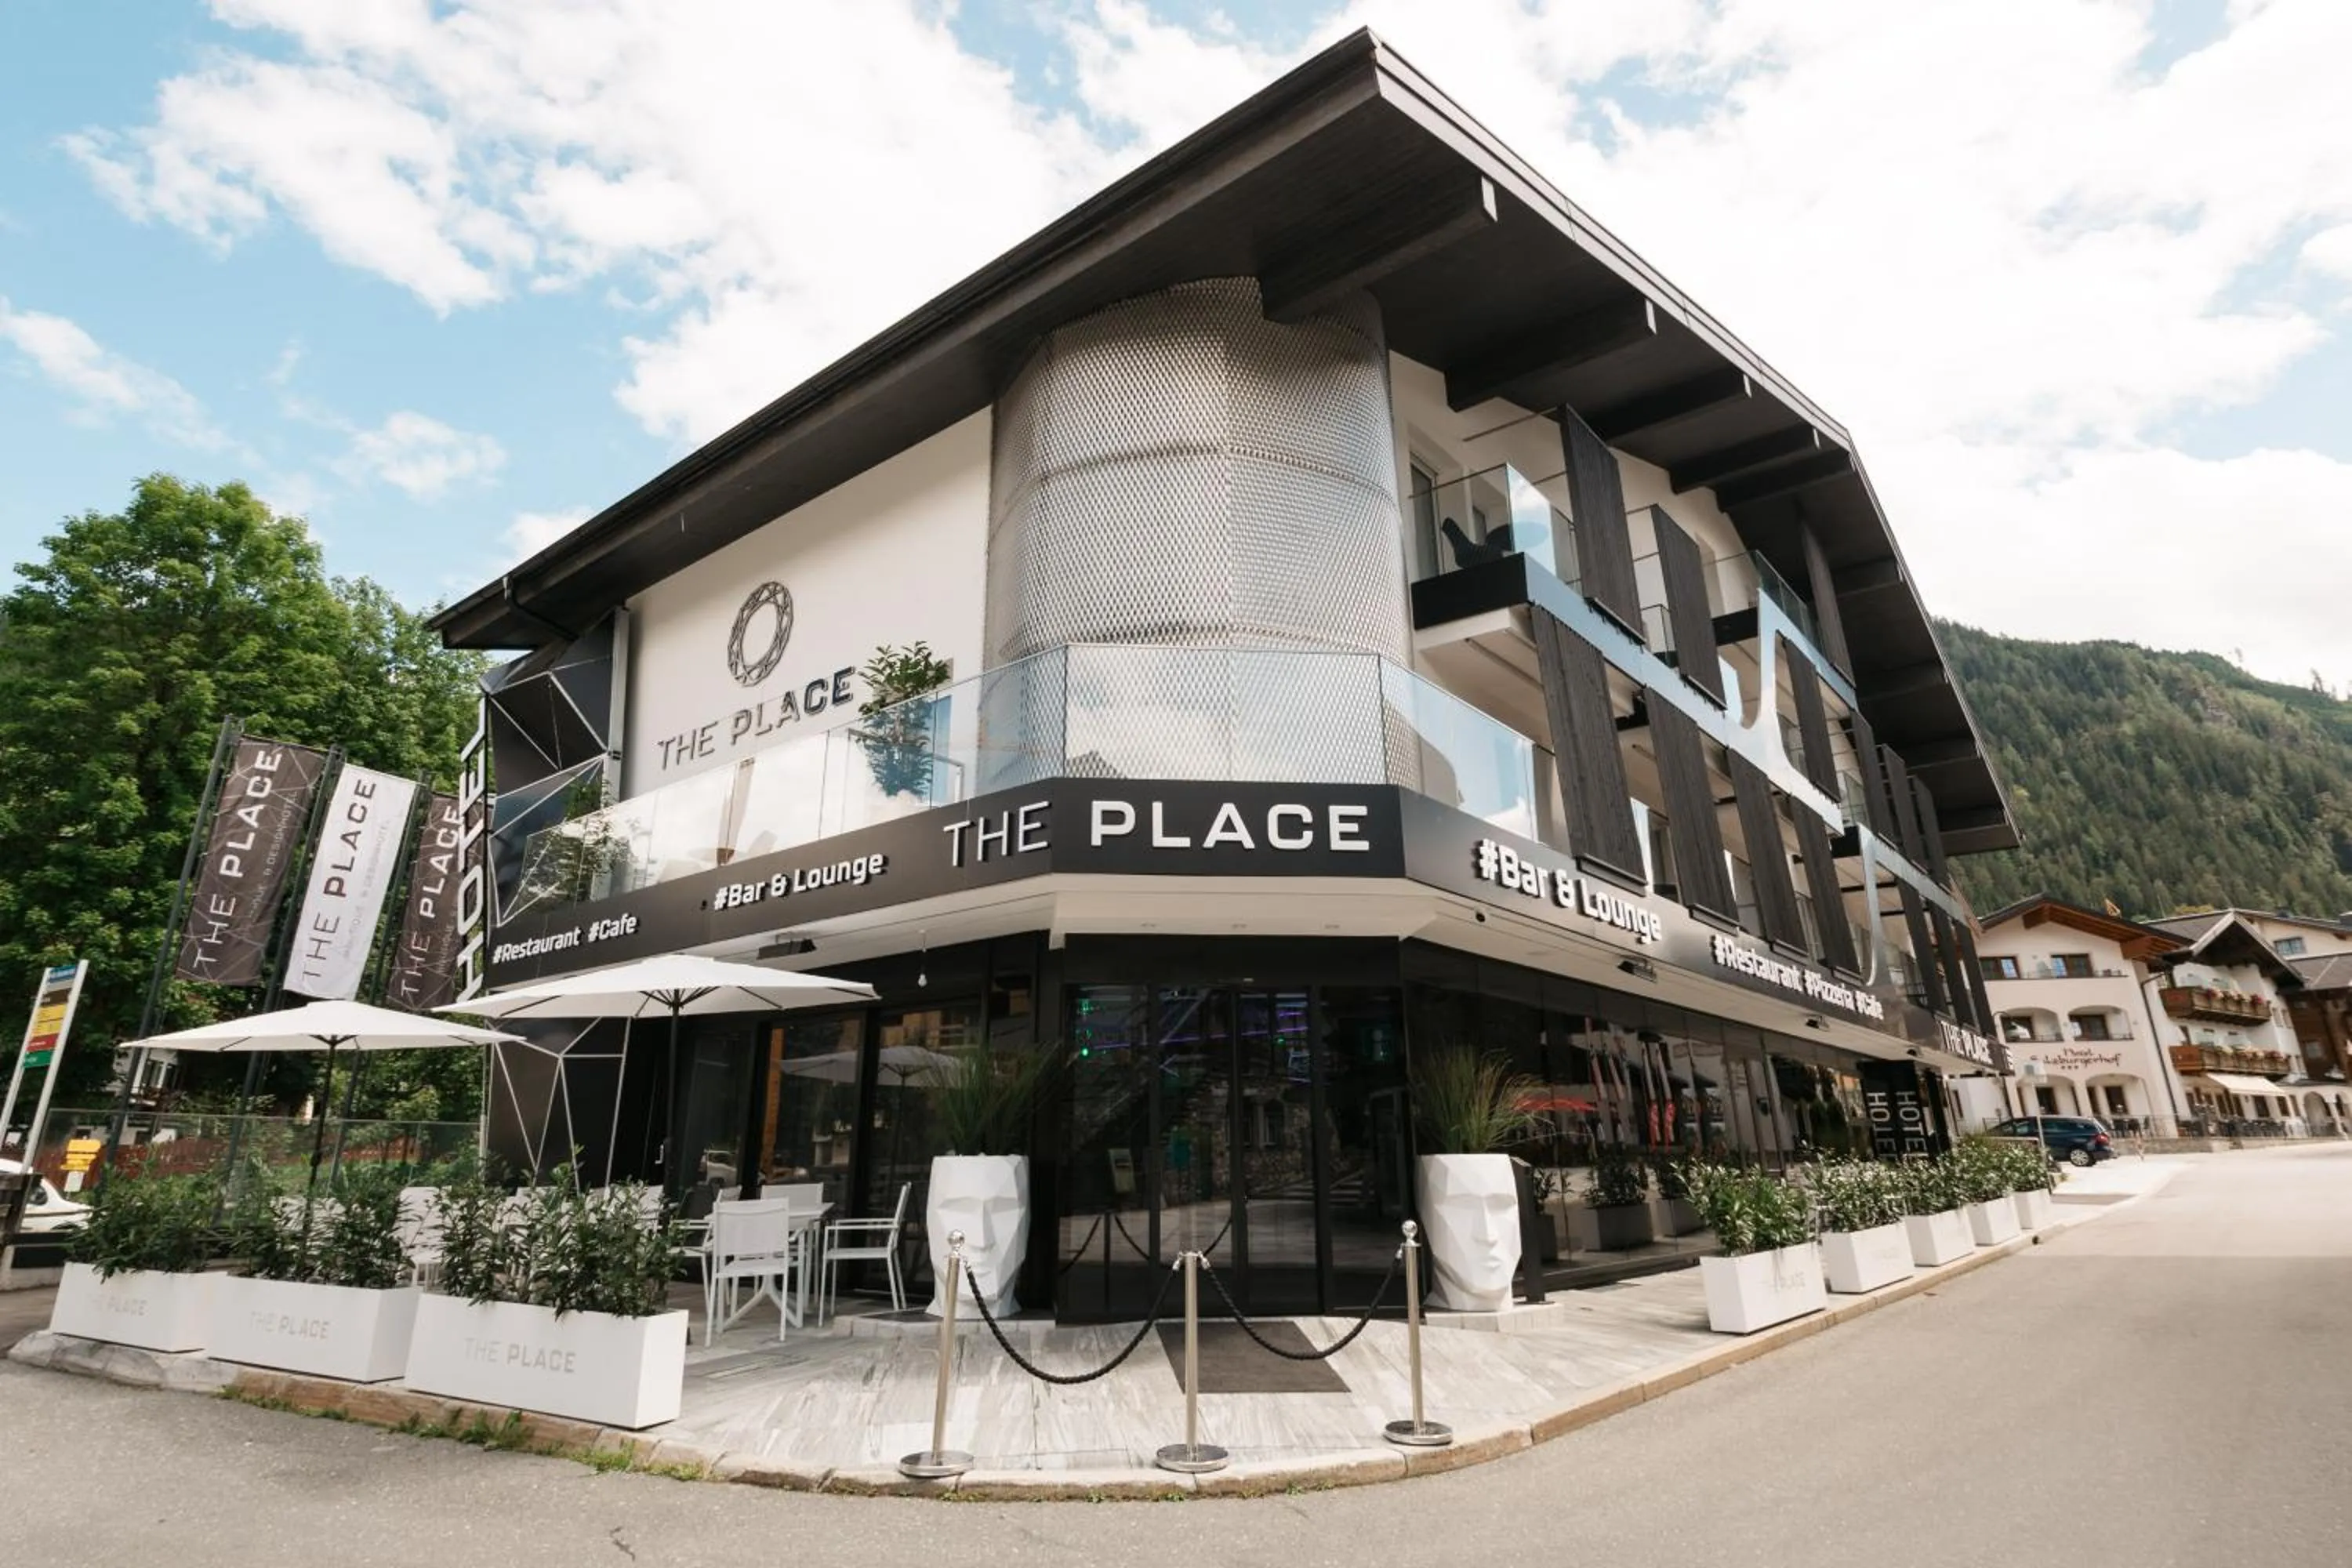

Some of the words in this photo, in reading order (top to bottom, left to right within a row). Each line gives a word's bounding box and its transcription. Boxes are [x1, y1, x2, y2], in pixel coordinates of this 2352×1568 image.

[657, 721, 718, 770] THE
[731, 666, 855, 745] PLACE
[192, 893, 236, 968] THE
[220, 750, 283, 878] PLACE
[457, 697, 486, 1004] HOTEL
[943, 800, 1051, 866] THE
[1091, 800, 1370, 851] PLACE
[303, 911, 340, 981] THE
[323, 779, 376, 898] PLACE
[401, 931, 430, 996] THE
[419, 805, 464, 919] PLACE
[714, 880, 765, 910] #Bar
[770, 873, 787, 897] &
[793, 852, 885, 892] Lounge
[1479, 838, 1548, 898] #Bar
[1555, 869, 1576, 907] &
[1581, 877, 1663, 945] Lounge
[492, 926, 581, 964] #Restaurant
[588, 912, 637, 943] #Cafe
[1715, 934, 1802, 992] #Restaurant
[278, 1316, 330, 1339] PLACE
[464, 1338, 501, 1363] THE
[507, 1343, 576, 1374] PLACE
